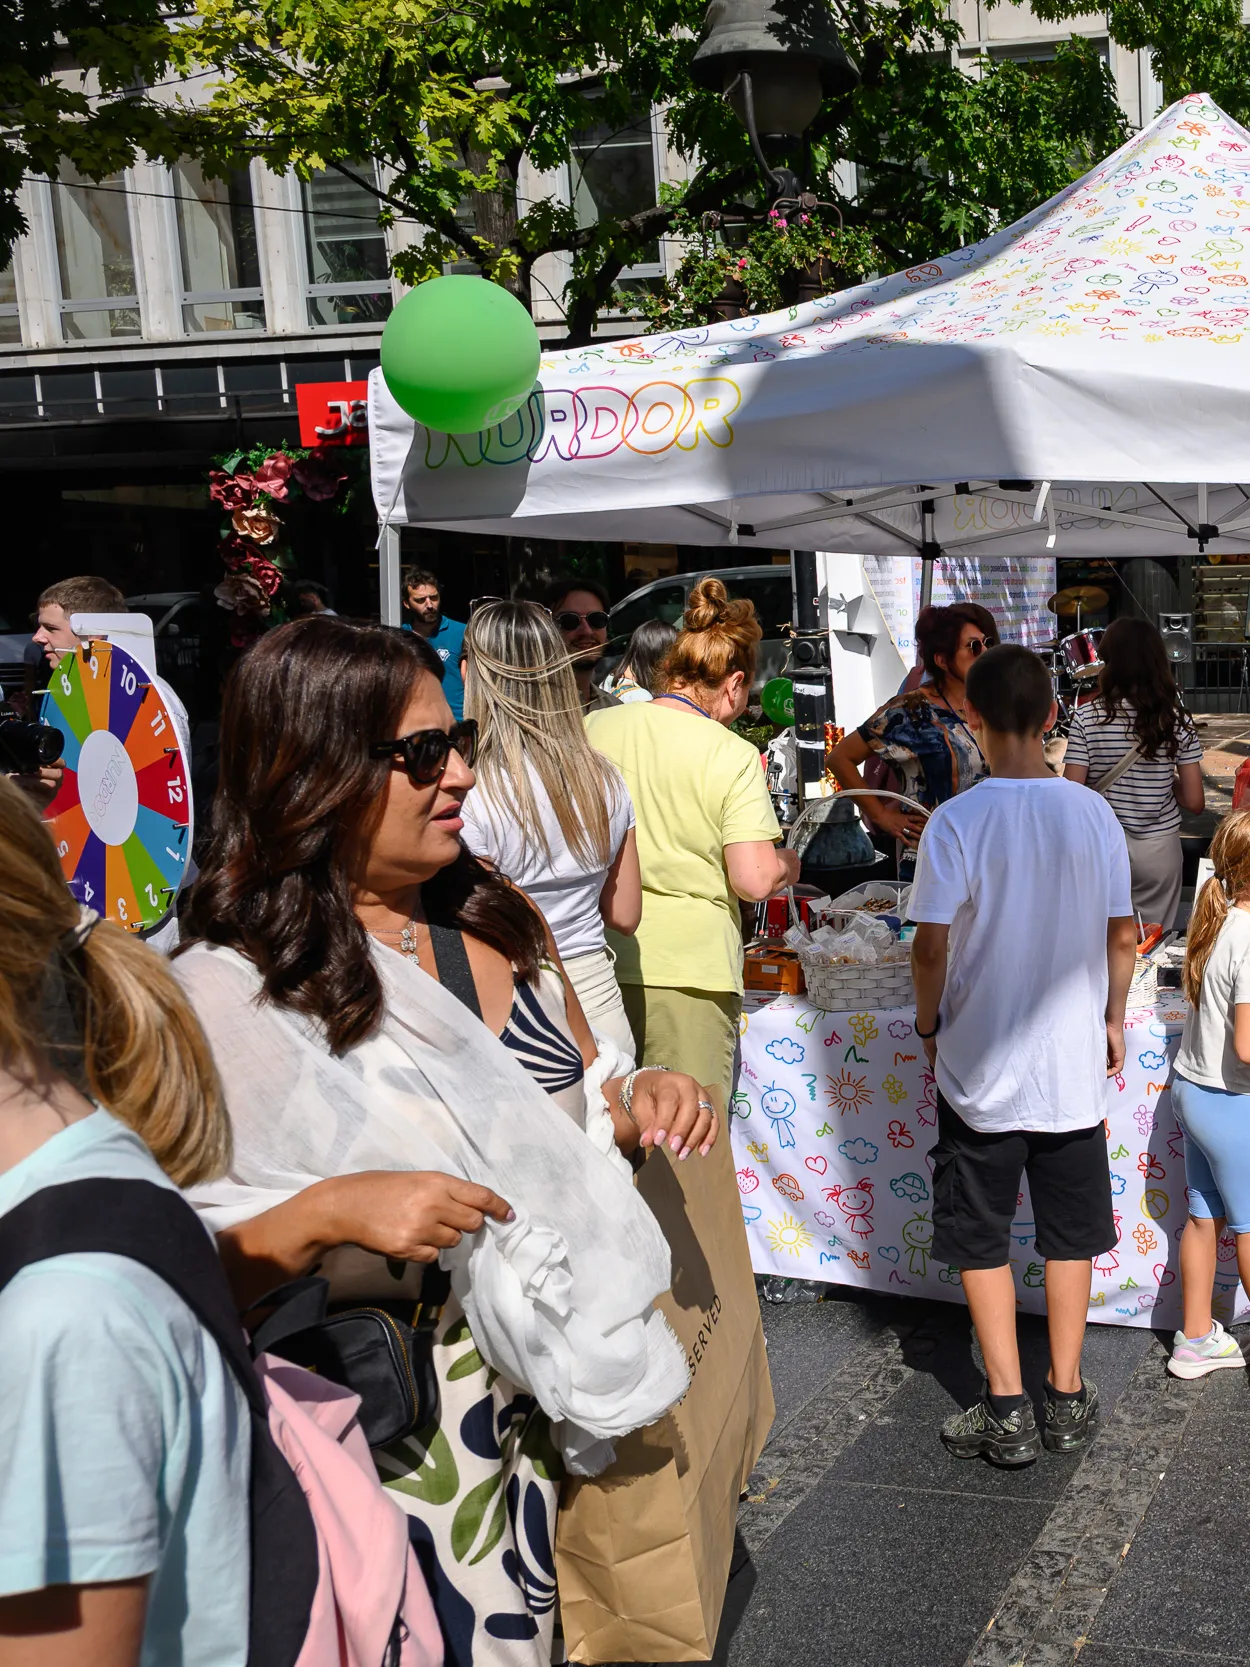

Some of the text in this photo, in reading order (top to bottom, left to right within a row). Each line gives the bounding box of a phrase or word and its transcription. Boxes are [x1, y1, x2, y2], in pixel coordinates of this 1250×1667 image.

[89, 656, 99, 680] 9
[60, 674, 72, 696] 8
[120, 665, 137, 696] 10
[150, 709, 167, 737] 11
[166, 775, 184, 804] 12
[165, 846, 180, 862] 1
[83, 881, 95, 902] 4
[145, 883, 159, 907] 2
[117, 897, 128, 921] 3
